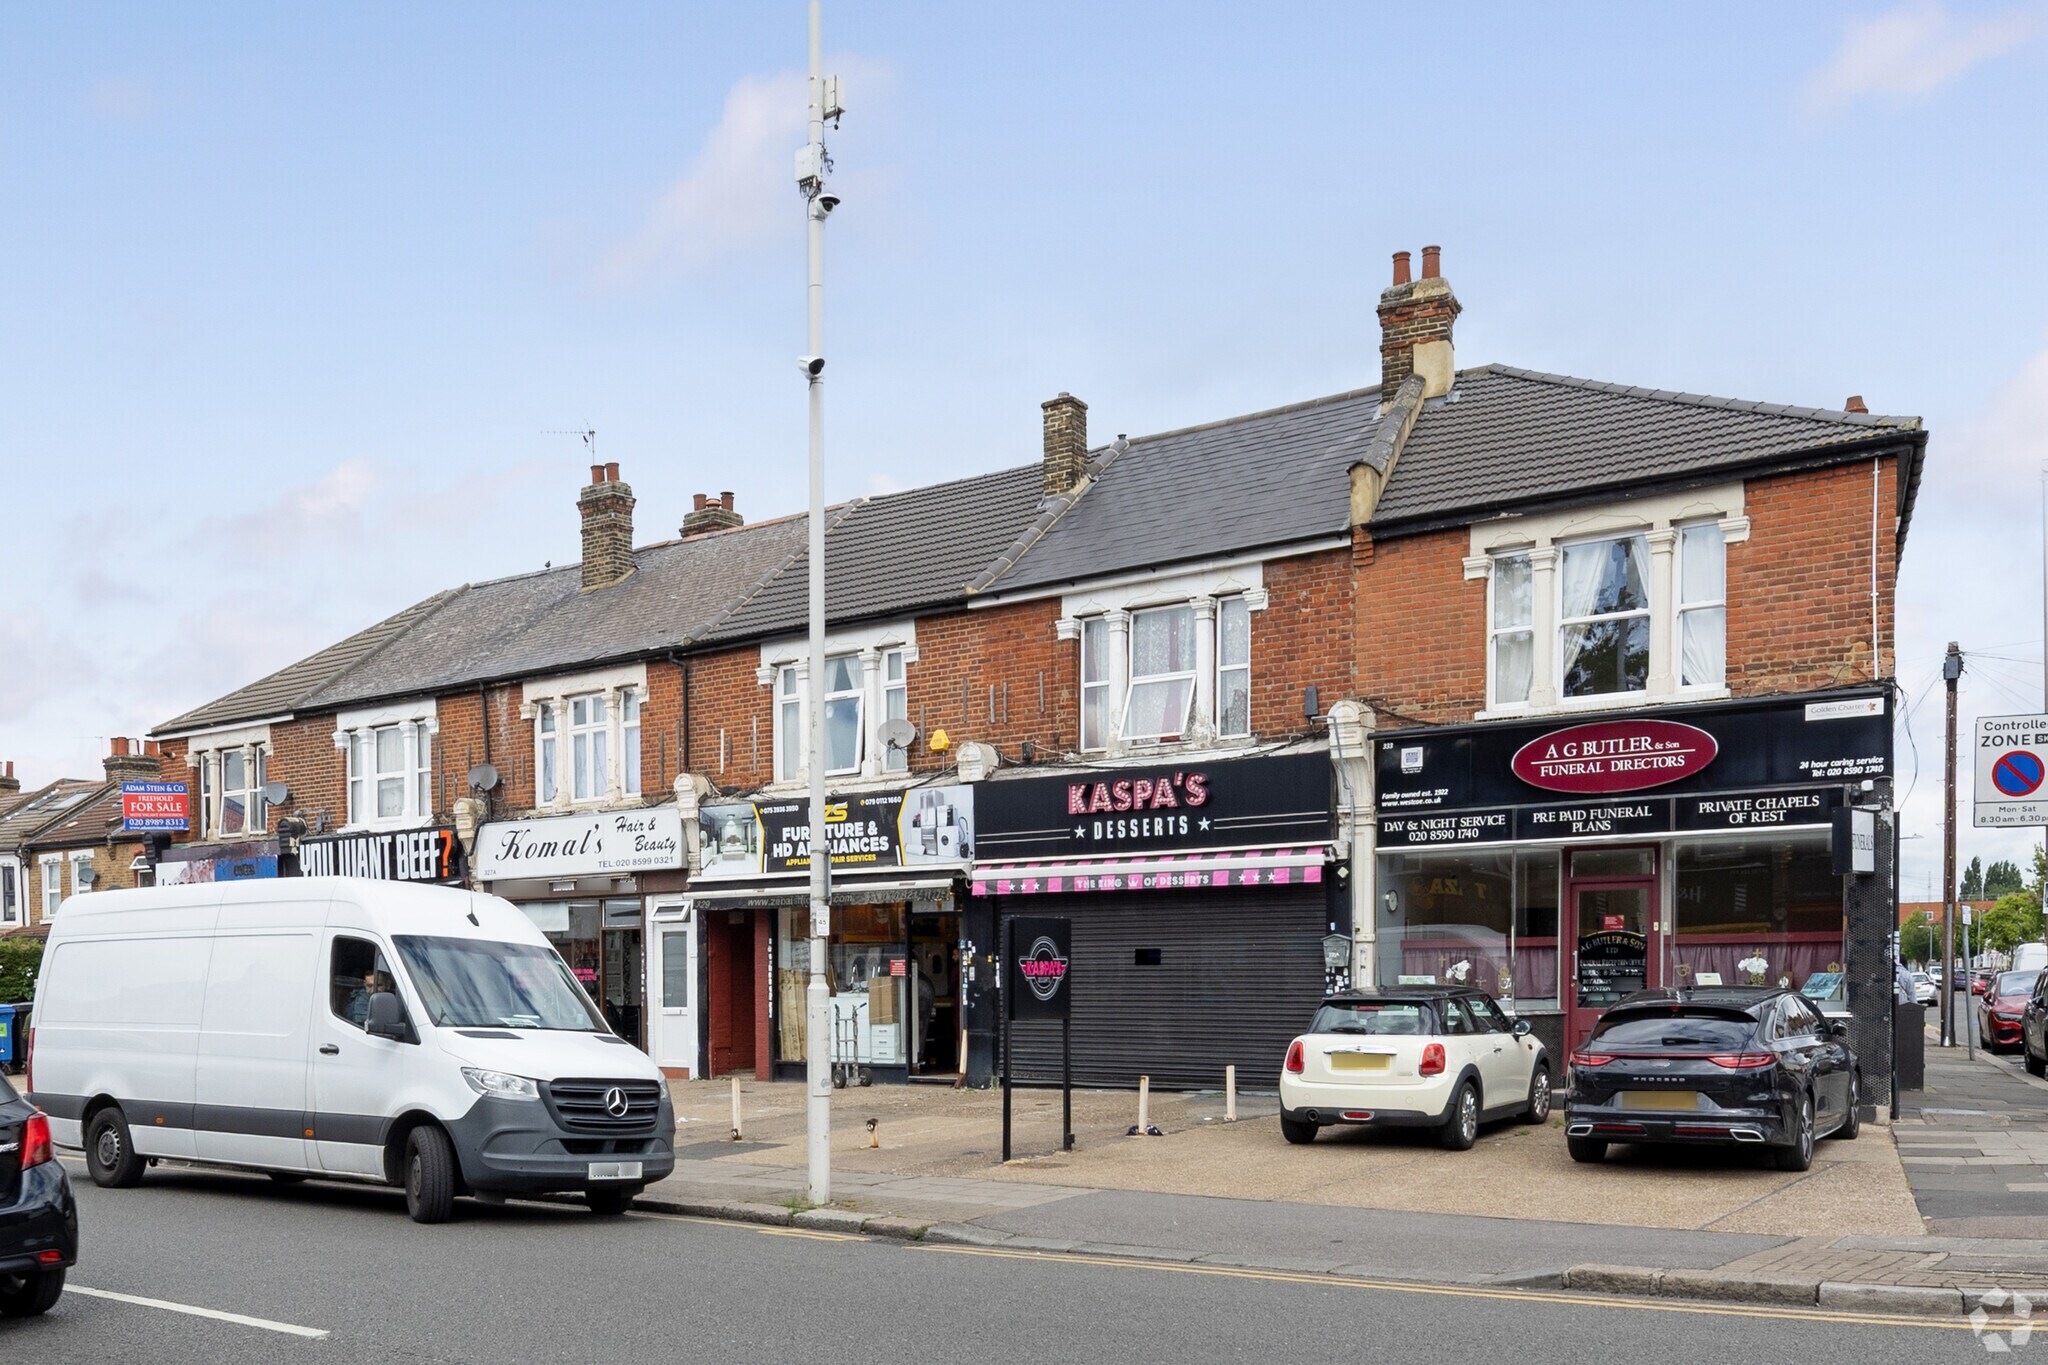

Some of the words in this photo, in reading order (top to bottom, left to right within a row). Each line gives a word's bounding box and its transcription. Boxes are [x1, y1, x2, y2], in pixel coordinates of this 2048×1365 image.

[1984, 720, 2047, 731] Controlle
[1545, 744, 1559, 758] A
[1563, 743, 1577, 756] G
[1582, 736, 1653, 756] BUTLER
[1665, 741, 1680, 749] Son
[1981, 734, 2031, 747] ZONE
[1540, 762, 1604, 777] FUNERAL
[1610, 755, 1685, 771] DIRECTORS
[1799, 761, 1809, 769] 24
[1811, 760, 1829, 768] hour
[1830, 758, 1854, 766] caring
[1856, 756, 1884, 765] service
[1812, 769, 1826, 777] Tel:
[1827, 768, 1842, 776] 020
[1843, 766, 1863, 775] 8590
[1865, 765, 1884, 773] 1740
[1068, 771, 1207, 814] KASPA'S
[1382, 792, 1400, 800] Family
[1401, 791, 1421, 799] owned
[131, 802, 154, 812] FOR
[157, 802, 182, 812] SALE
[1699, 799, 1752, 813] PRIVATE
[1755, 795, 1819, 810] CHAPELS
[1533, 811, 1556, 823] PRE
[1559, 809, 1586, 821] PAID
[1590, 805, 1652, 819] FUNERAL
[1729, 812, 1747, 823] OF
[1751, 810, 1787, 823] REST
[615, 816, 644, 833] Hair
[647, 817, 656, 830] &
[1094, 815, 1188, 840] DESSERTS
[1384, 821, 1405, 832] DAY
[1407, 821, 1418, 830] &
[1421, 818, 1457, 829] NIGHT
[1460, 814, 1506, 827] SERVICE
[1572, 820, 1611, 833] PLANS
[782, 822, 864, 842] FURTURE
[868, 820, 878, 836] &
[1409, 831, 1427, 841] 020
[1430, 829, 1455, 840] 8590
[1457, 828, 1479, 838] 1740
[495, 823, 602, 861] Komal's
[635, 835, 677, 854] Beauty
[300, 842, 334, 877] YOU
[338, 835, 392, 880] WANT
[396, 829, 453, 880] BEEF?
[773, 842, 794, 858] HD
[653, 856, 674, 864] 0321
[846, 854, 876, 862] SERVICES
[1077, 879, 1096, 888] THE
[1098, 878, 1122, 888] KING
[1143, 876, 1157, 887] OF
[1159, 875, 1209, 886] DESSERTS
[695, 900, 710, 909] 329
[1592, 936, 1622, 946] BUTLER
[1630, 938, 1646, 951] SON
[1025, 961, 1062, 976] KASPA'S
